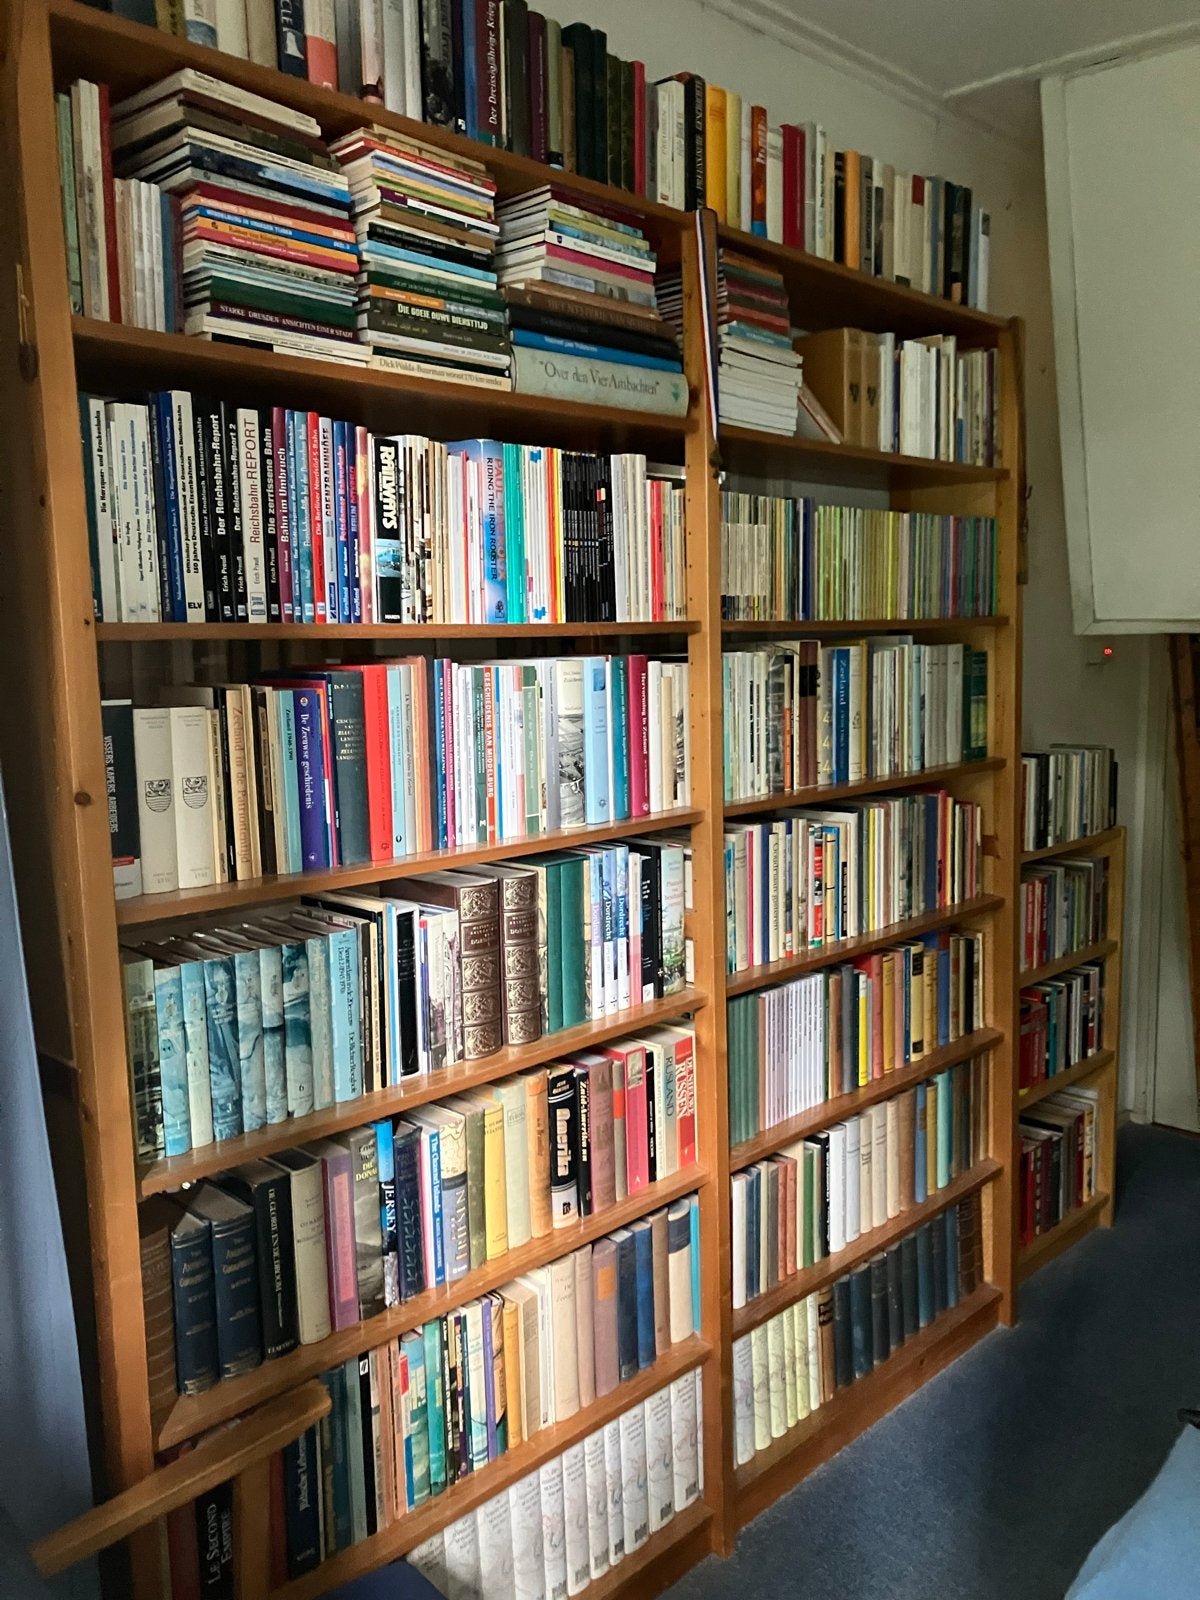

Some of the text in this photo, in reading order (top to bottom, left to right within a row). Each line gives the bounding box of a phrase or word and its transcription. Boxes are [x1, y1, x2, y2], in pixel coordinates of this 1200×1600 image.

[486, 1, 496, 28] Krieg
[489, 107, 498, 125] Der
[220, 305, 245, 316] STARKE
[249, 311, 279, 323] DRESDEN
[282, 319, 315, 331] ANSICHTEN
[336, 328, 353, 338] STADT
[398, 303, 409, 315] DIE
[452, 315, 488, 330] DIENSTTIJD
[573, 367, 588, 384] den
[95, 411, 103, 452] Brockenbahn
[264, 428, 272, 455] Bahn
[210, 414, 225, 514] Reichsbahn-Report
[230, 432, 240, 513] Reichsbahn-Report
[244, 418, 261, 543] Reichsbahn-REPORT
[278, 448, 286, 496] Umbruch
[494, 458, 503, 501] PAUL
[266, 458, 274, 514] zerrissene
[280, 500, 287, 512] im
[379, 446, 397, 529] RAILWAYS
[217, 517, 226, 535] Der
[268, 518, 276, 534] Die
[280, 514, 289, 542] Bahn
[490, 538, 498, 580] ROOSTER
[484, 672, 492, 728] GESCHIEDENIS
[642, 717, 647, 725] in
[104, 735, 114, 766] VISSERS,
[231, 707, 243, 752] Zeeland
[235, 755, 244, 766] in
[236, 772, 246, 784] de
[300, 714, 314, 809] De Zeeuwse geschiedenis
[299, 1084, 304, 1092] 6
[665, 1056, 674, 1117] RUSLAND
[675, 1062, 688, 1120] RUSSEN
[580, 1081, 588, 1147] Zuid-Amerika
[556, 1108, 571, 1177] Amerika
[381, 1183, 396, 1233] JERSEY
[433, 1185, 441, 1213] Islands
[206, 1503, 221, 1584] LE SECOND
[220, 1506, 232, 1564] EMPIRE
